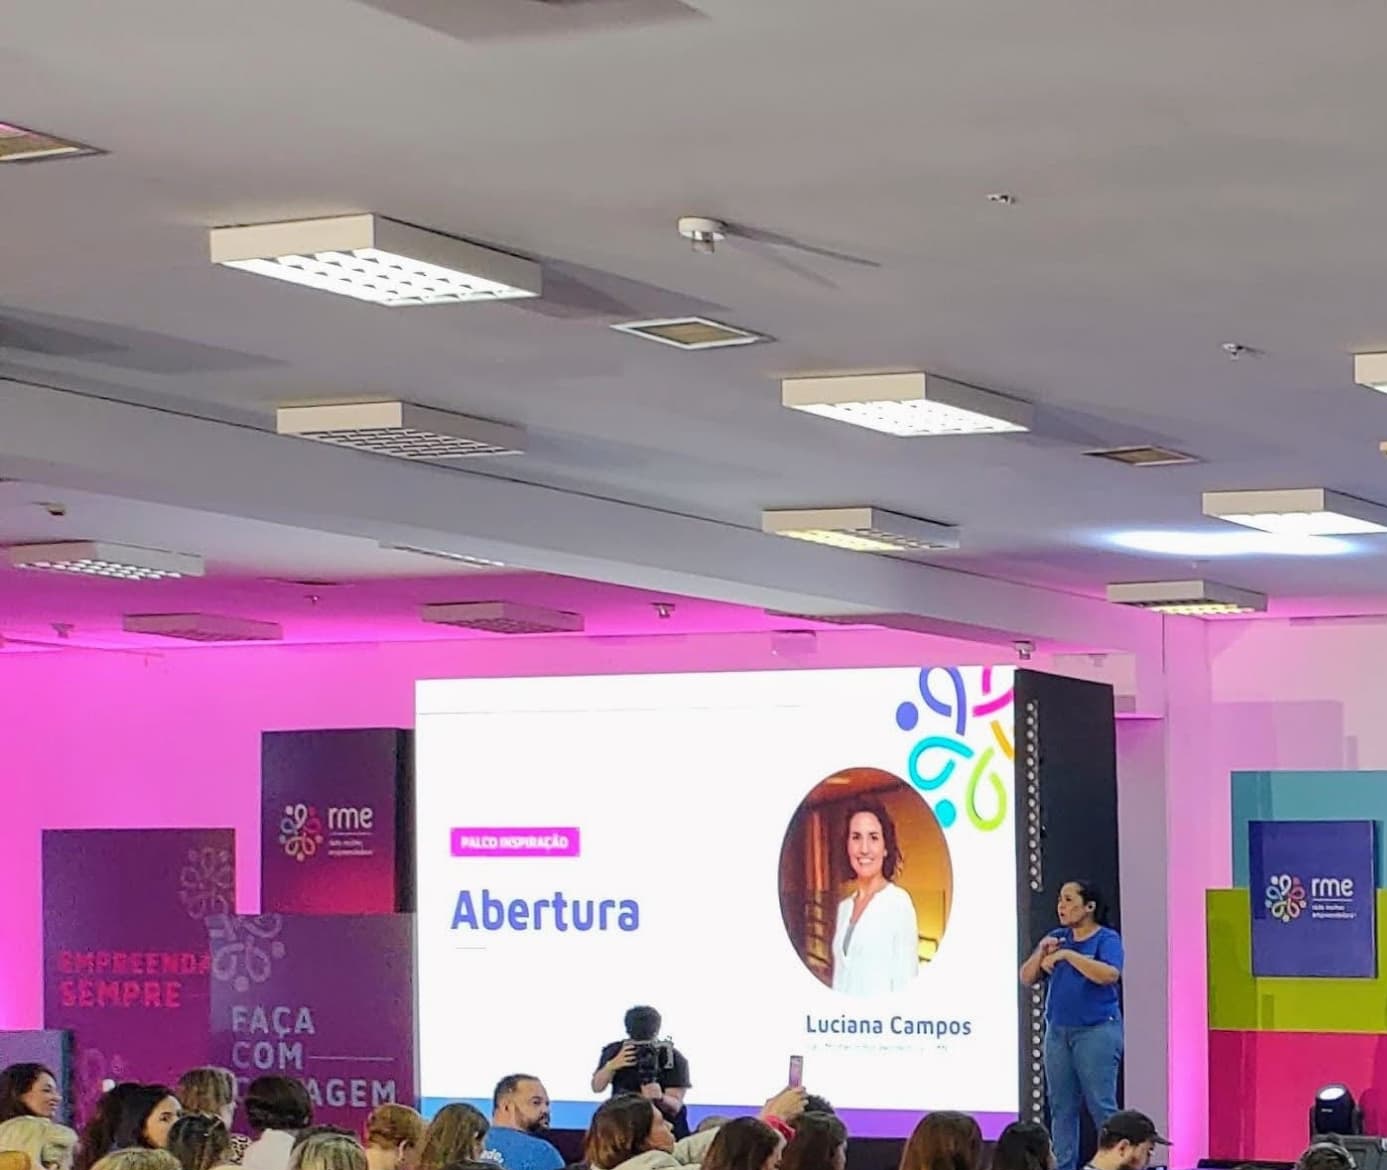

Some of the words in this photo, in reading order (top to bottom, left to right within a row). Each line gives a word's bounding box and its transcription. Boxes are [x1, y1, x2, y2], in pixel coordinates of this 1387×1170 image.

[328, 807, 373, 830] rme
[460, 835, 498, 849] PALCO
[499, 833, 569, 852] INSPIRAÇÃO
[1311, 878, 1354, 898] rme
[451, 888, 640, 932] Abertura
[59, 981, 182, 1008] SEMPRE
[231, 1005, 316, 1038] FAÇA
[806, 1014, 883, 1034] Luciana
[890, 1015, 972, 1039] Campos
[231, 1042, 304, 1069] COM
